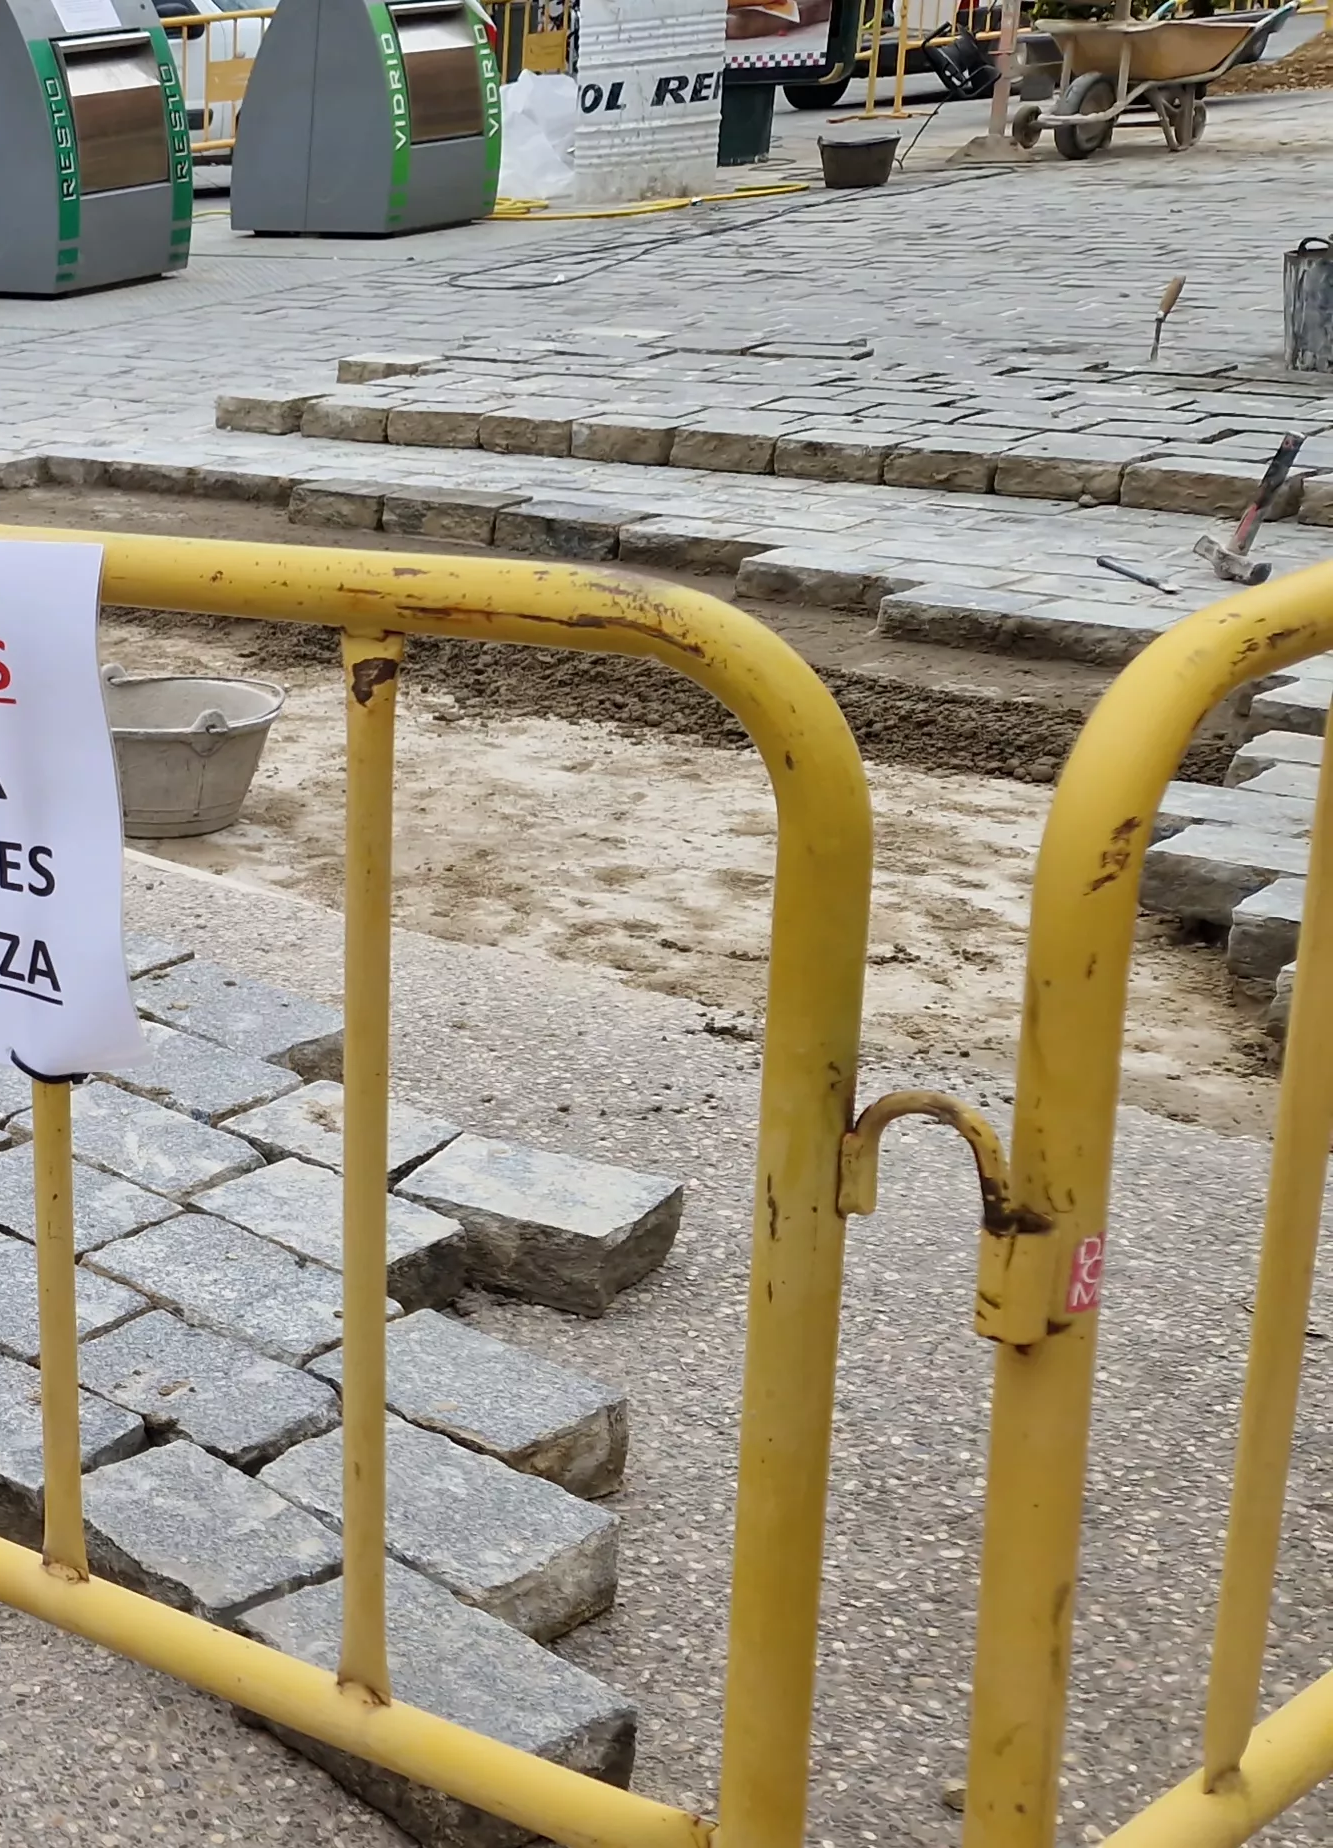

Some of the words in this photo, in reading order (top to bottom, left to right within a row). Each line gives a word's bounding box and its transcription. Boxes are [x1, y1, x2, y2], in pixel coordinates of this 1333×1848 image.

[44, 77, 77, 201] RESTO
[158, 65, 189, 183] RESTO
[381, 33, 407, 151] VIDRIO
[473, 24, 500, 138] VIDRIO
[577, 81, 627, 114] OL
